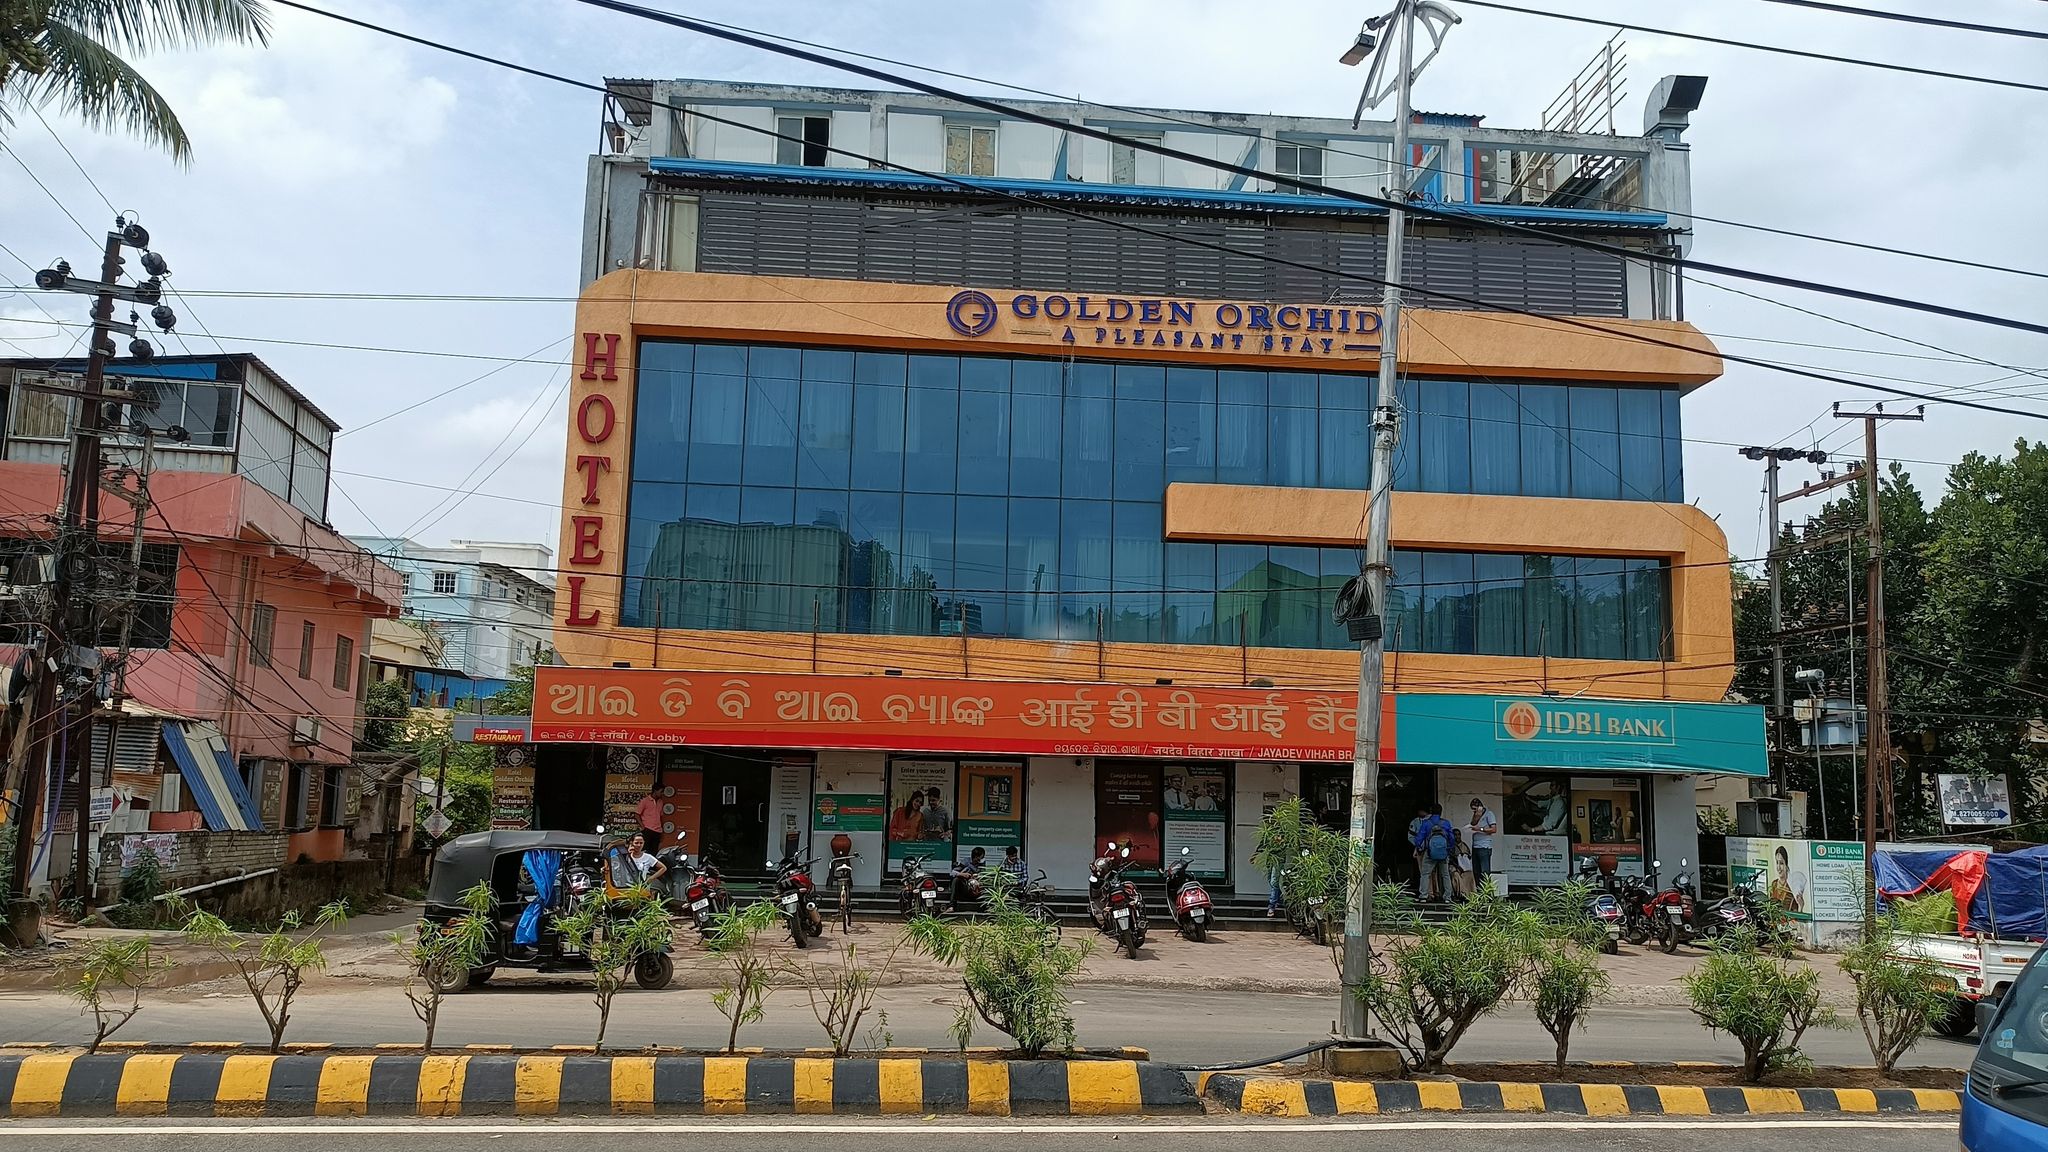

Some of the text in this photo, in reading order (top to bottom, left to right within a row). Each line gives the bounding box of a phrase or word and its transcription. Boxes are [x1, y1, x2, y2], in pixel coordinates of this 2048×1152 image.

[1011, 294, 1383, 334] GOLDEN ORCHID
[1061, 326, 1333, 353] A PLEASANT STAY
[565, 332, 621, 626] HOTEL
[548, 684, 639, 717] ଆଇ
[717, 679, 751, 719] ବି
[774, 690, 862, 722] ଆଇ
[1019, 688, 1099, 734] आई
[1107, 688, 1149, 729] डी
[1156, 690, 1202, 730] बी
[1210, 693, 1290, 739] आई
[1546, 711, 1666, 737] IDBI BANK
[474, 734, 523, 742] RESTAURANT
[638, 733, 687, 744] e-Lobby
[1152, 744, 1184, 756] जयदेव
[1218, 748, 1245, 757] शाखा
[1257, 748, 1303, 759] JAYADEV
[1306, 749, 1336, 760] VIHAR
[1827, 846, 1844, 854] IDBI
[1962, 952, 1978, 960] HORN
